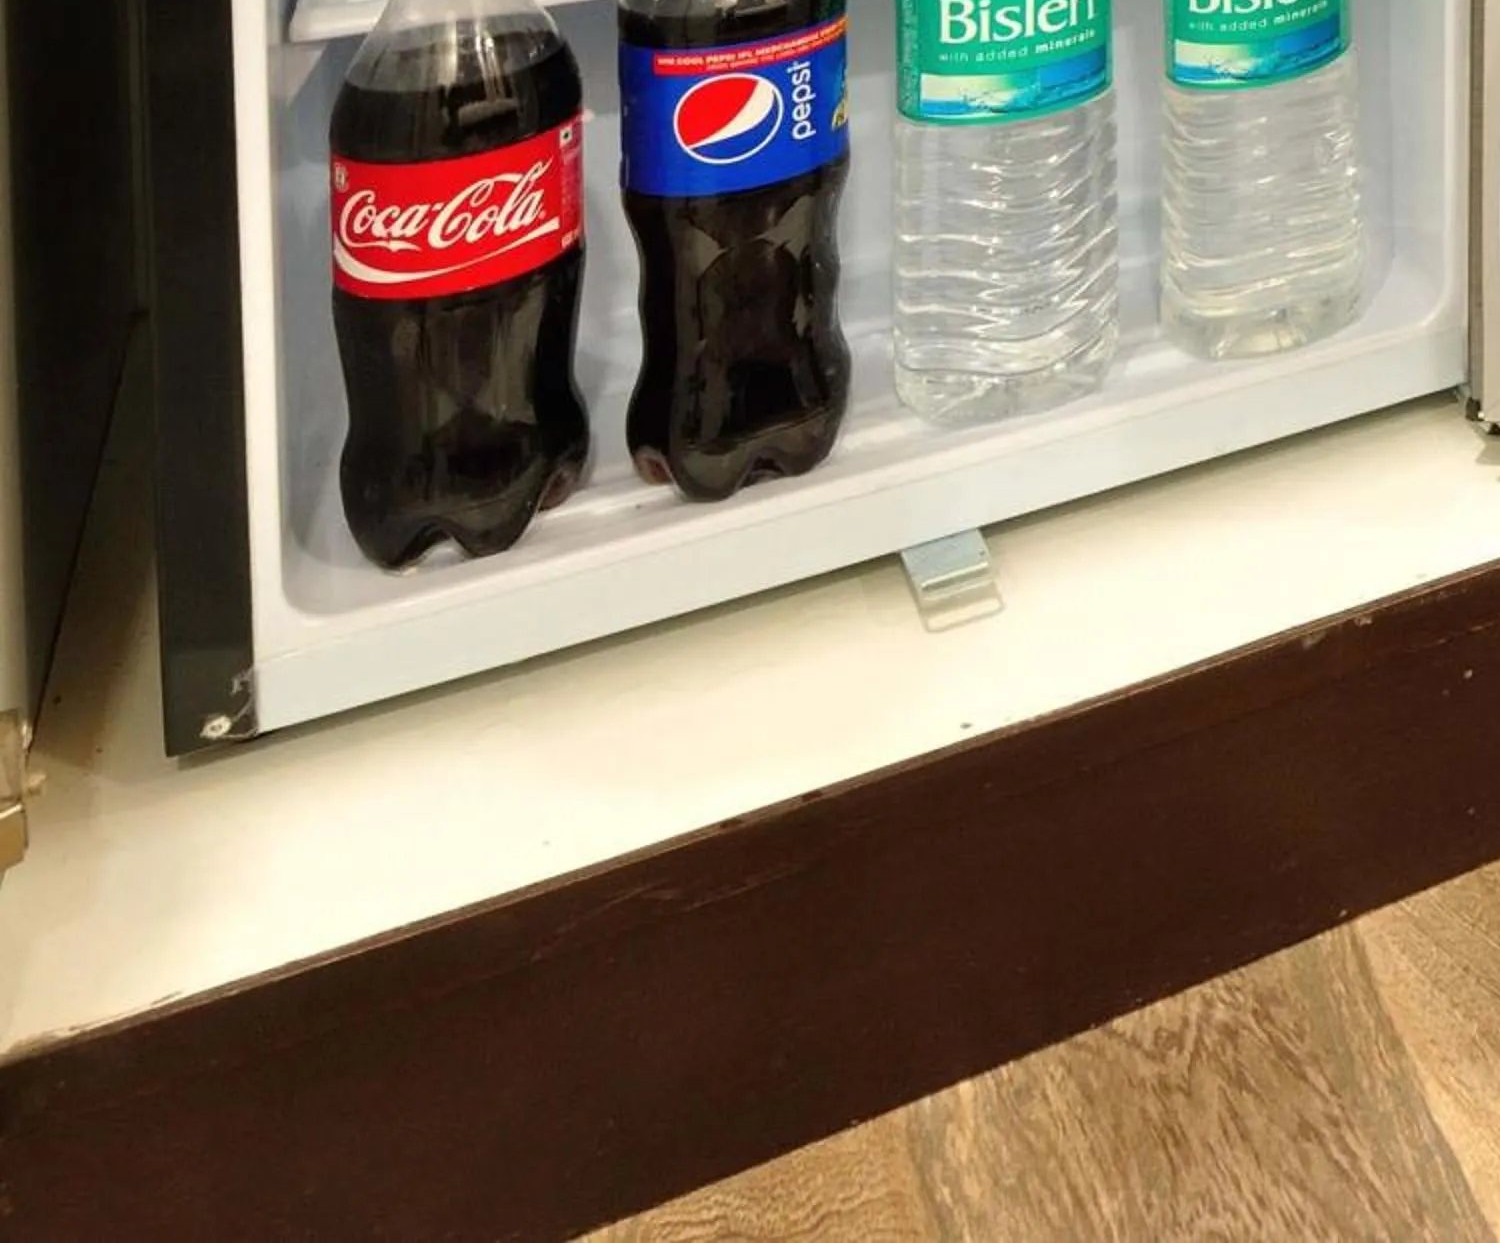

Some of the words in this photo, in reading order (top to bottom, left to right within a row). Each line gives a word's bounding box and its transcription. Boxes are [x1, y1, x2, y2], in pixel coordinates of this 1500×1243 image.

[976, 46, 1028, 62] added
[1035, 28, 1096, 54] minerals
[1220, 18, 1267, 32] added
[787, 61, 817, 140] pepsi
[340, 157, 553, 253] Coca-Cola
